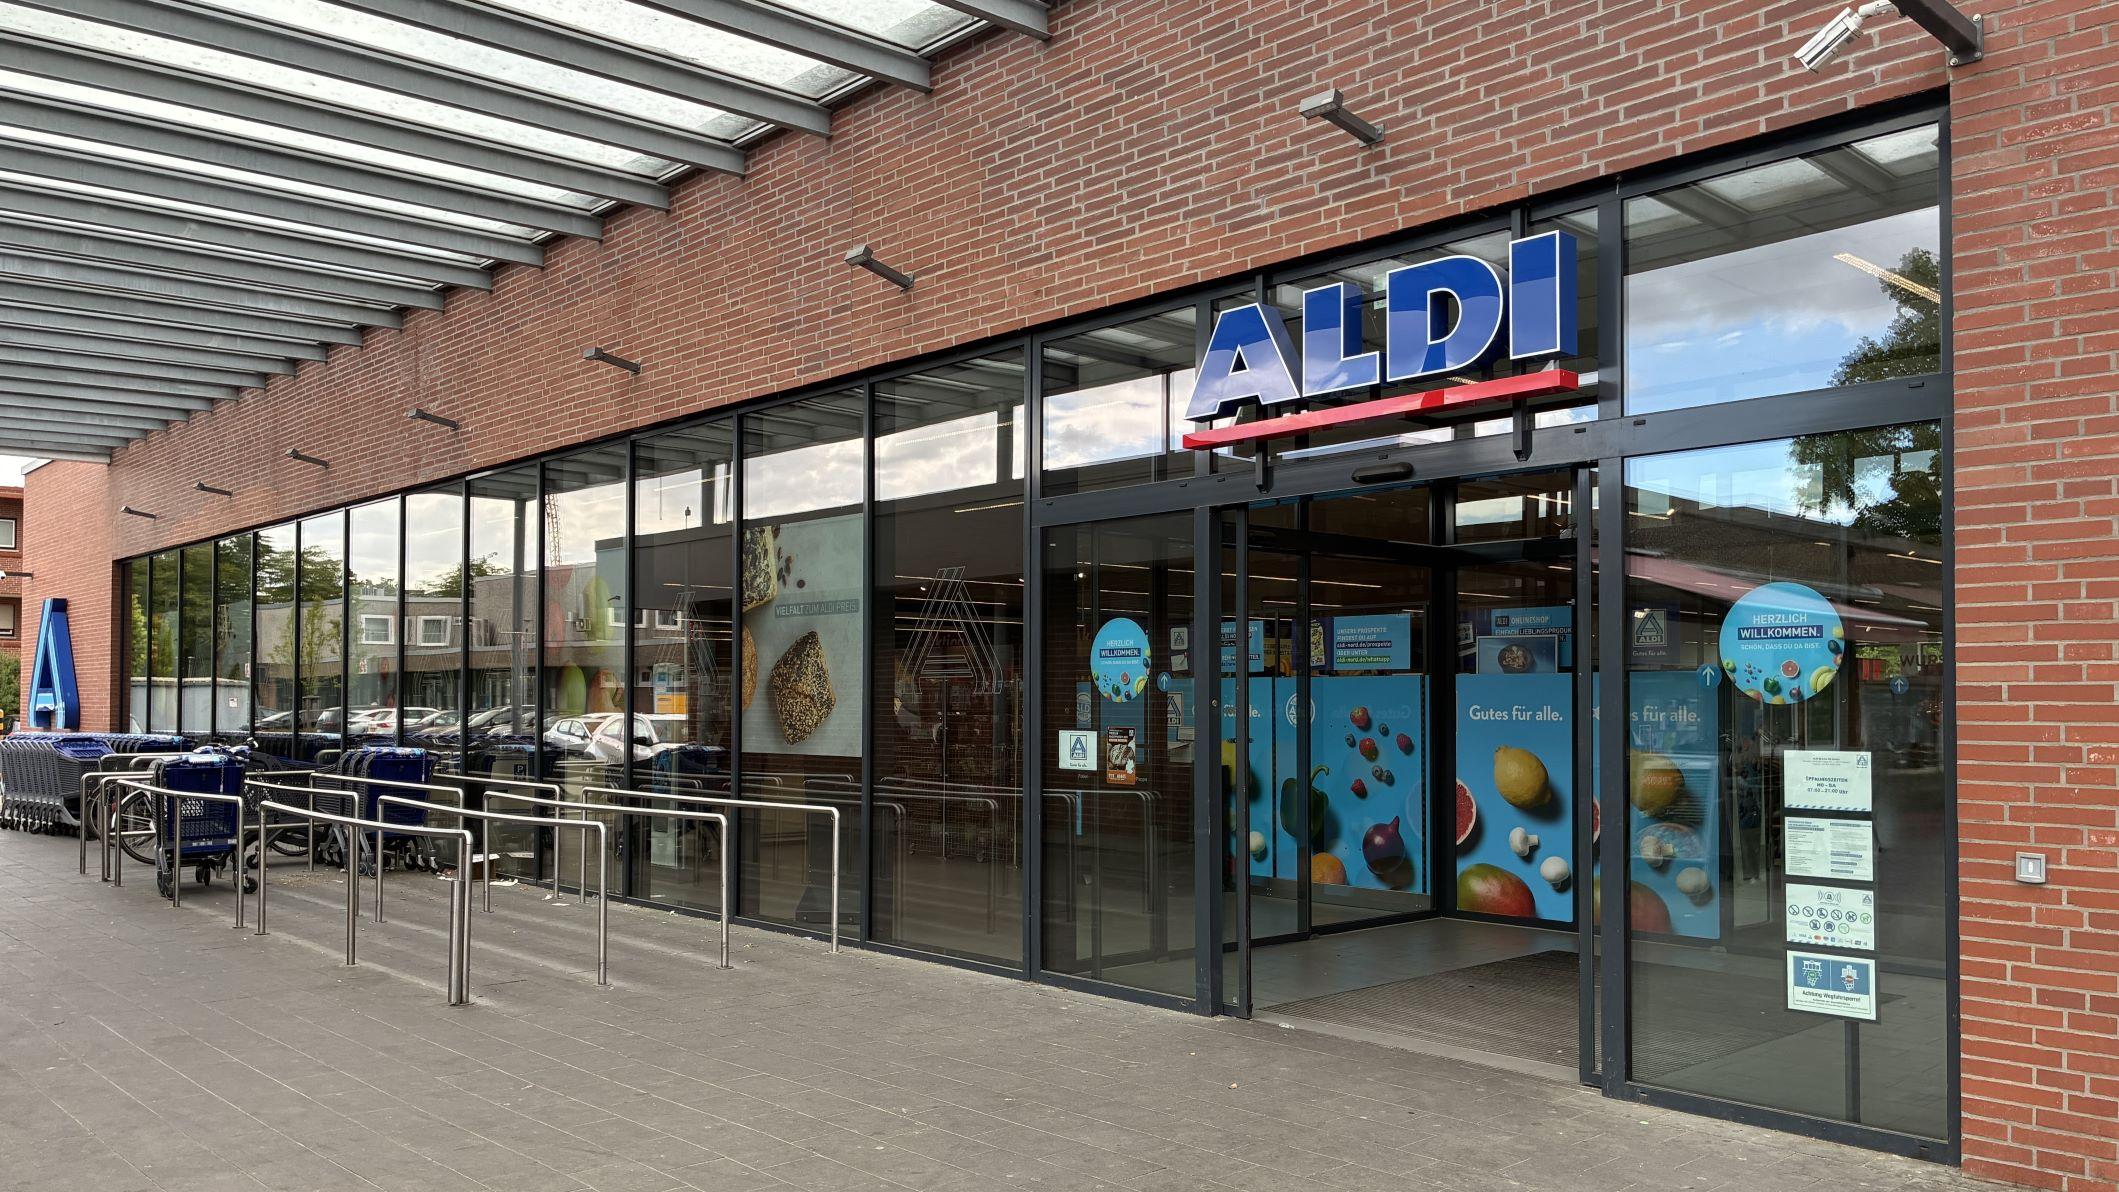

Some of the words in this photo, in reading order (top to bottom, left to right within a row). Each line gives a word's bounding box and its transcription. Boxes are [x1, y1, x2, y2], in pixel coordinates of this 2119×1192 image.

[1184, 230, 1577, 421] ALDI
[775, 605, 804, 616] VIELFALT
[1511, 616, 1550, 625] ONLINESHOP
[1753, 613, 1807, 625] HERZLICH
[1639, 635, 1661, 643] ALDI
[1740, 627, 1820, 639] WILLKOMMEN.
[1469, 705, 1509, 721] Gutes
[1512, 705, 1532, 721] für
[1535, 705, 1563, 721] alle.
[1642, 705, 1666, 721] für
[1670, 705, 1701, 721] alle.
